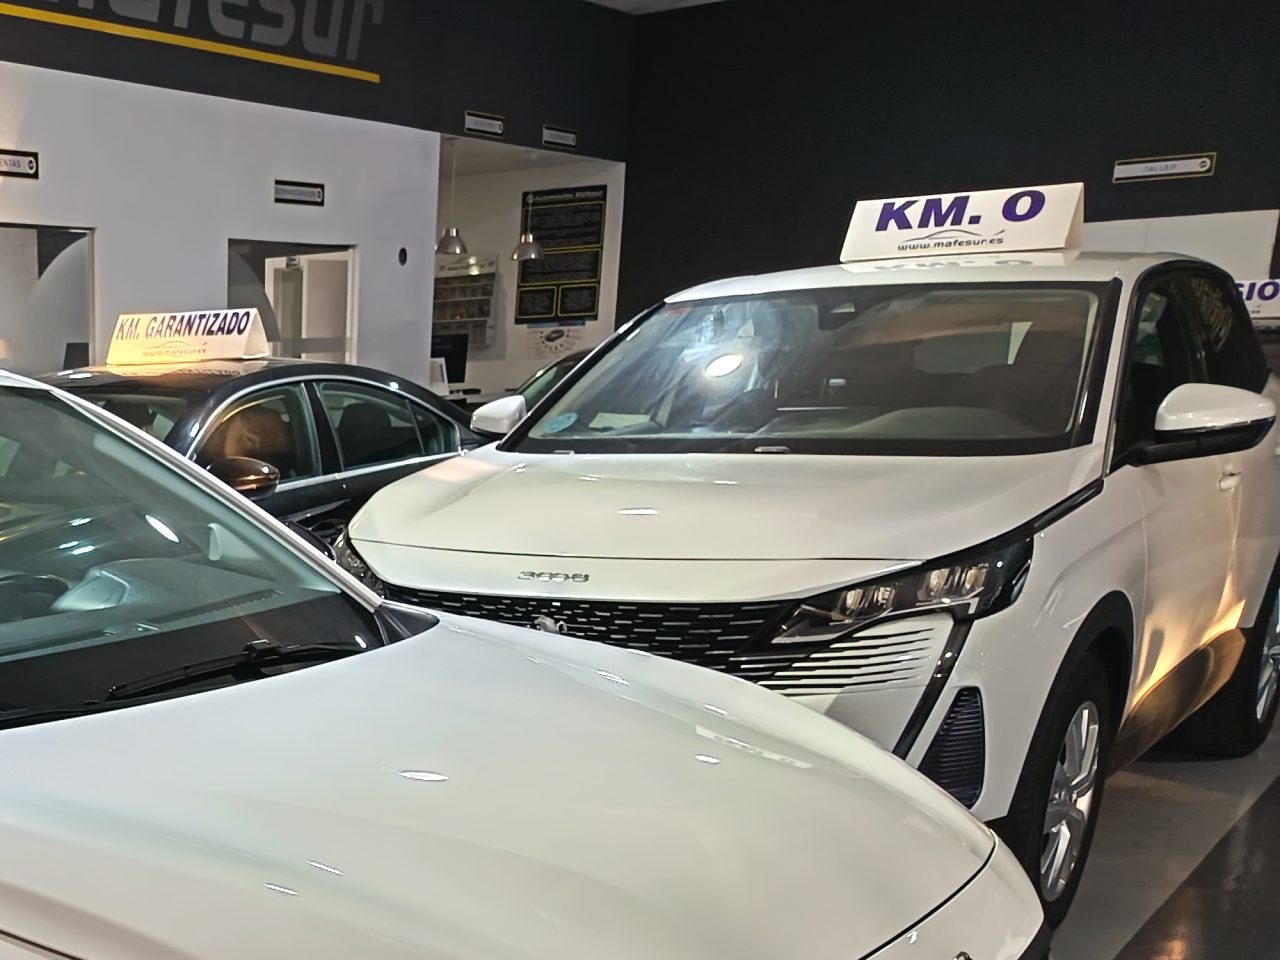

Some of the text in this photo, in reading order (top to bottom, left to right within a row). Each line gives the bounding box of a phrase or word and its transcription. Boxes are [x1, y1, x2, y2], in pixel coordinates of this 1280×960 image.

[875, 194, 982, 232] KM.
[897, 237, 1004, 251] www.mafesur.es
[115, 310, 251, 341] KM. GARANTIZADO
